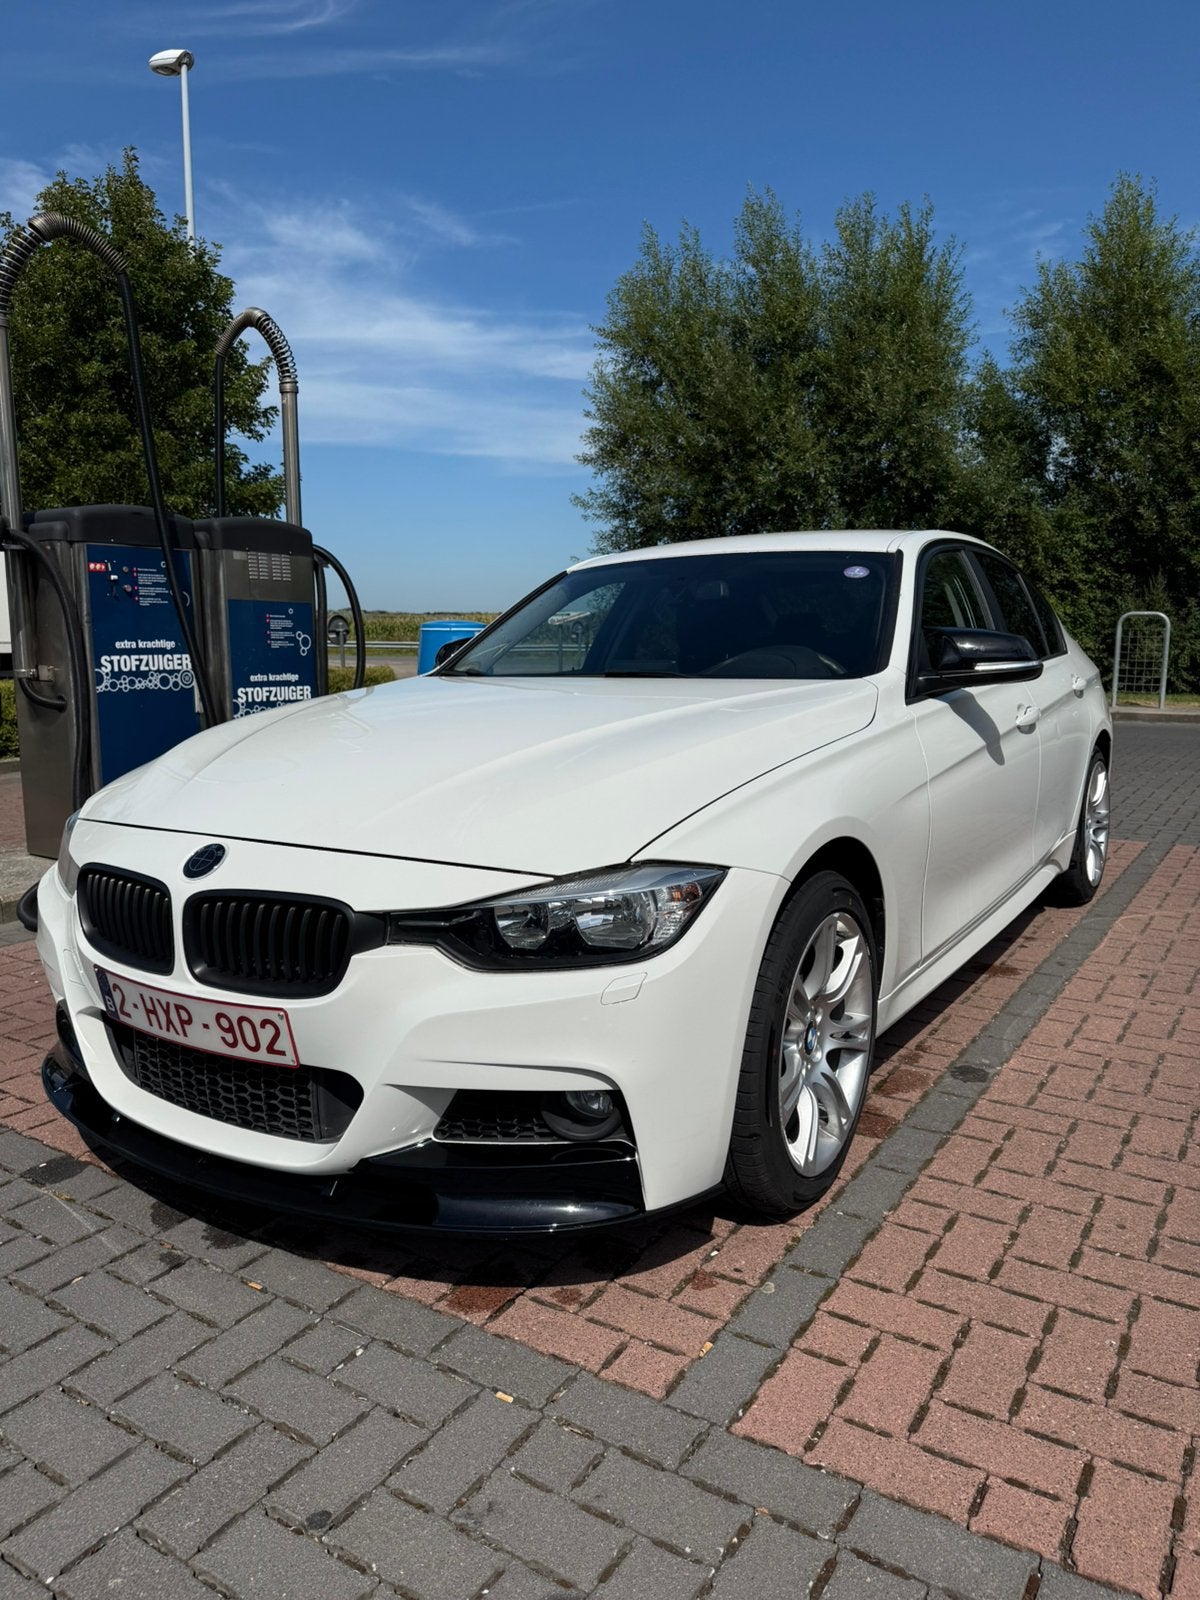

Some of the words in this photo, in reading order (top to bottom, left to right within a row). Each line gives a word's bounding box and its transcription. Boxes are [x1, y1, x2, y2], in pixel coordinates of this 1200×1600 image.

[115, 640, 136, 649] extra
[138, 639, 176, 650] krachtige
[100, 653, 192, 673] STOFZUIGER
[249, 673, 267, 682] extra
[268, 672, 299, 682] krachtige
[237, 685, 312, 703] STOFZUIGER
[106, 995, 115, 1012] B
[112, 982, 287, 1057] 2-HXP-902
